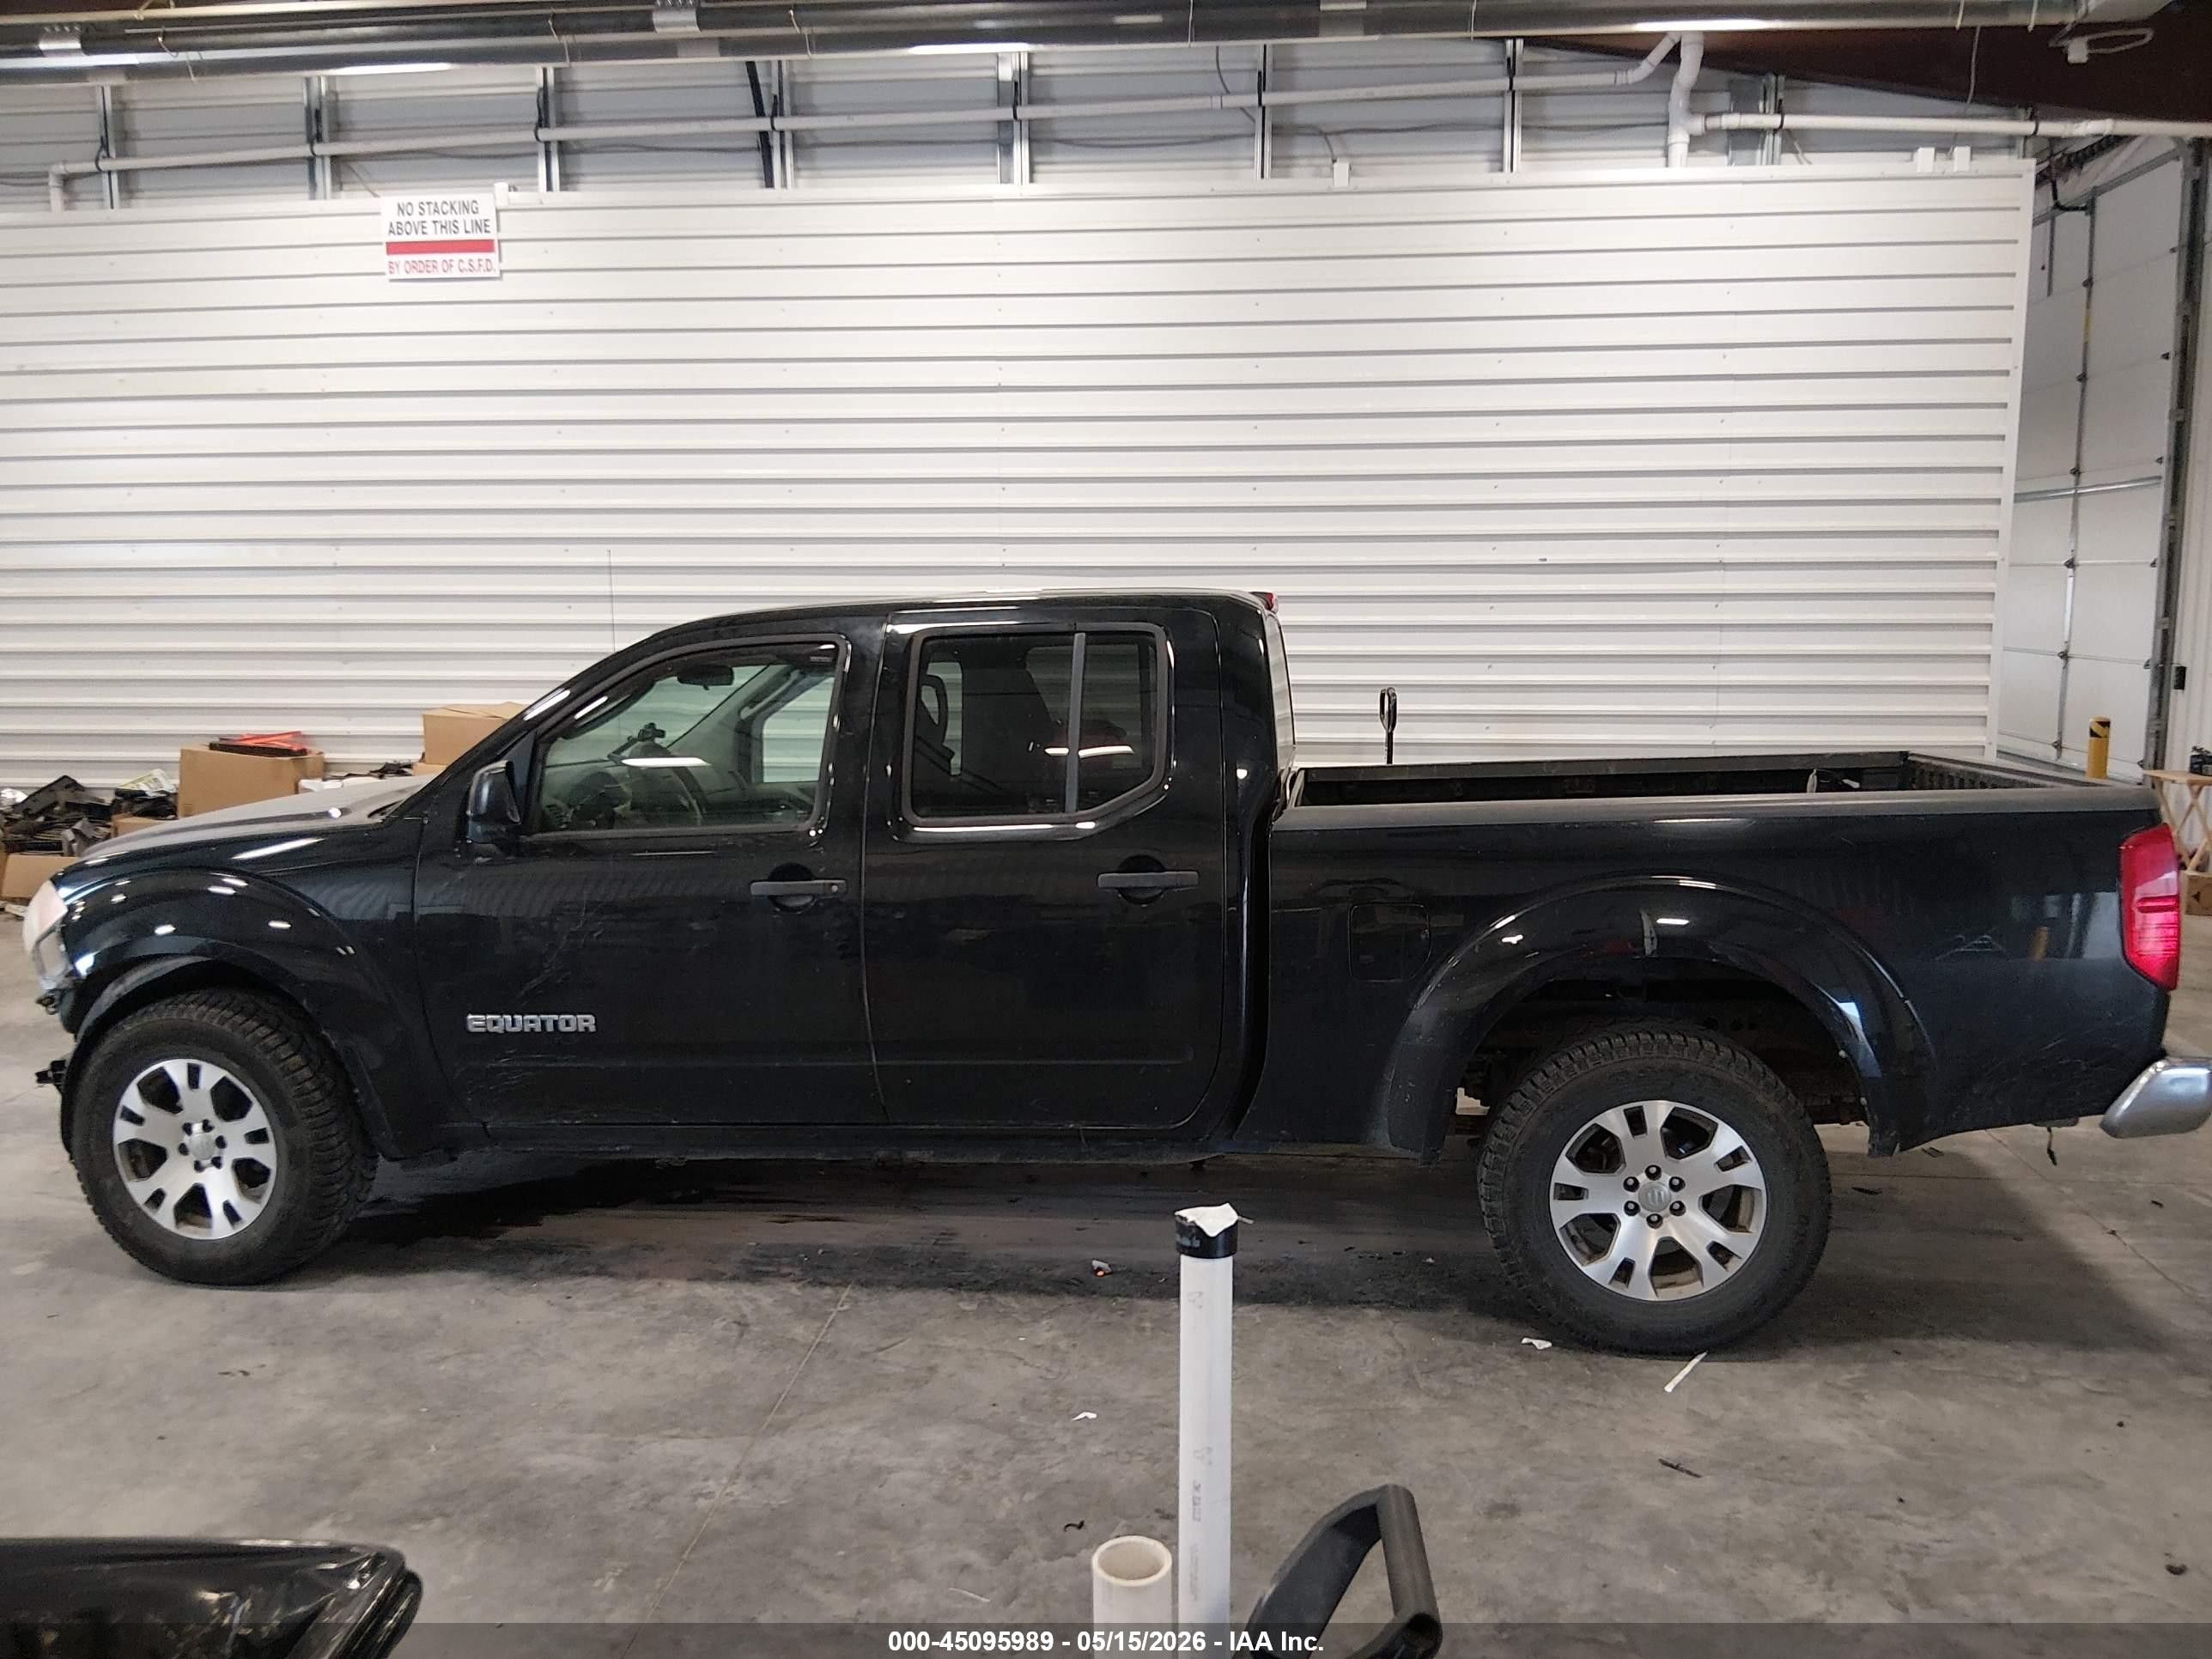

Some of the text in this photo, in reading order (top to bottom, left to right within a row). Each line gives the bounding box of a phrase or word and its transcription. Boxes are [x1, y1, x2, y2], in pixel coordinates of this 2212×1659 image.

[397, 199, 479, 216] NO STACKING
[388, 218, 491, 236] ABOVE THIS LINE
[388, 258, 495, 275] BY ORDER OF C.S.F.D.
[467, 1013, 597, 1033] EQUATOR
